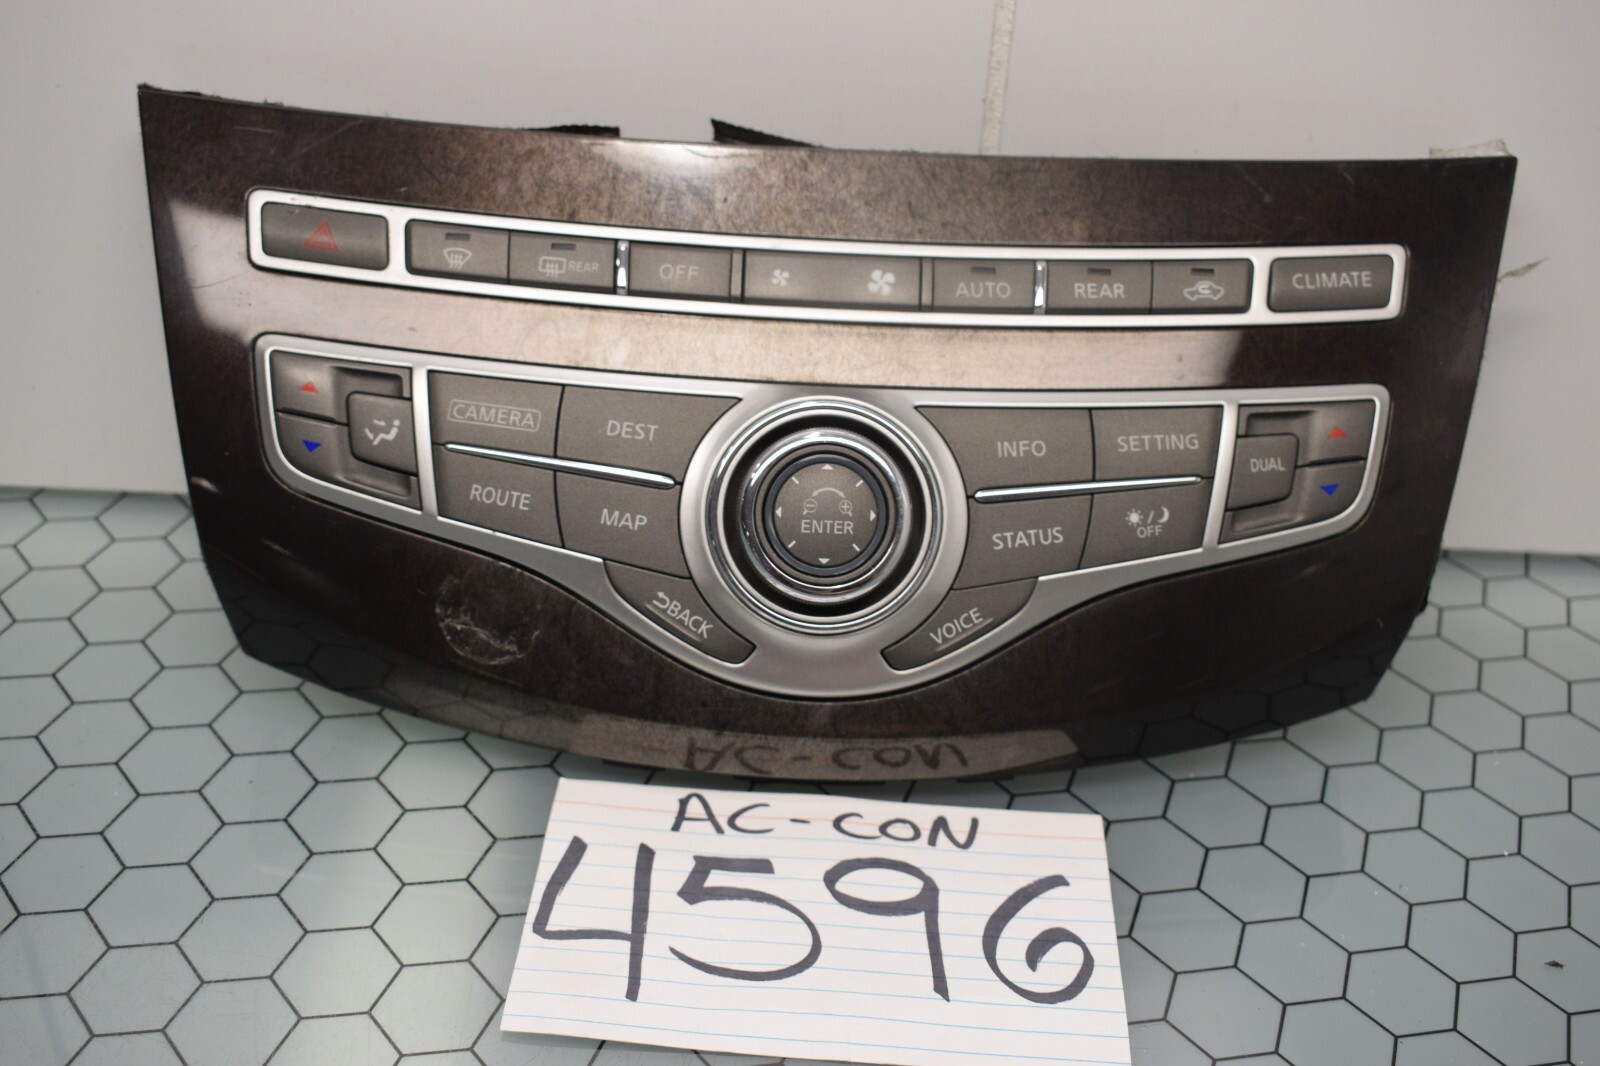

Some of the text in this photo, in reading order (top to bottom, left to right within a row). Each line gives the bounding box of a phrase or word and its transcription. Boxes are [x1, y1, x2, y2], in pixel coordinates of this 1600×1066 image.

[568, 259, 599, 274] REAR
[659, 263, 699, 282] OFF
[955, 281, 1011, 299] AUTO
[1073, 282, 1125, 299] REAR
[1291, 271, 1373, 290] CLIMATE
[452, 403, 535, 428] CAMERA
[606, 420, 658, 441] DEST
[996, 440, 1047, 458] INFO
[1116, 433, 1199, 453] SETTING
[1250, 457, 1286, 472] DUAL
[469, 484, 531, 511] ROUTE
[600, 508, 648, 531] MAP
[801, 519, 854, 535] ENTER
[992, 526, 1064, 550] STATUS
[1136, 524, 1163, 538] OFF
[666, 602, 714, 639] BACK
[929, 607, 984, 645] VOICE
[671, 792, 979, 850] AC-CON
[532, 835, 1095, 1004] 4596
